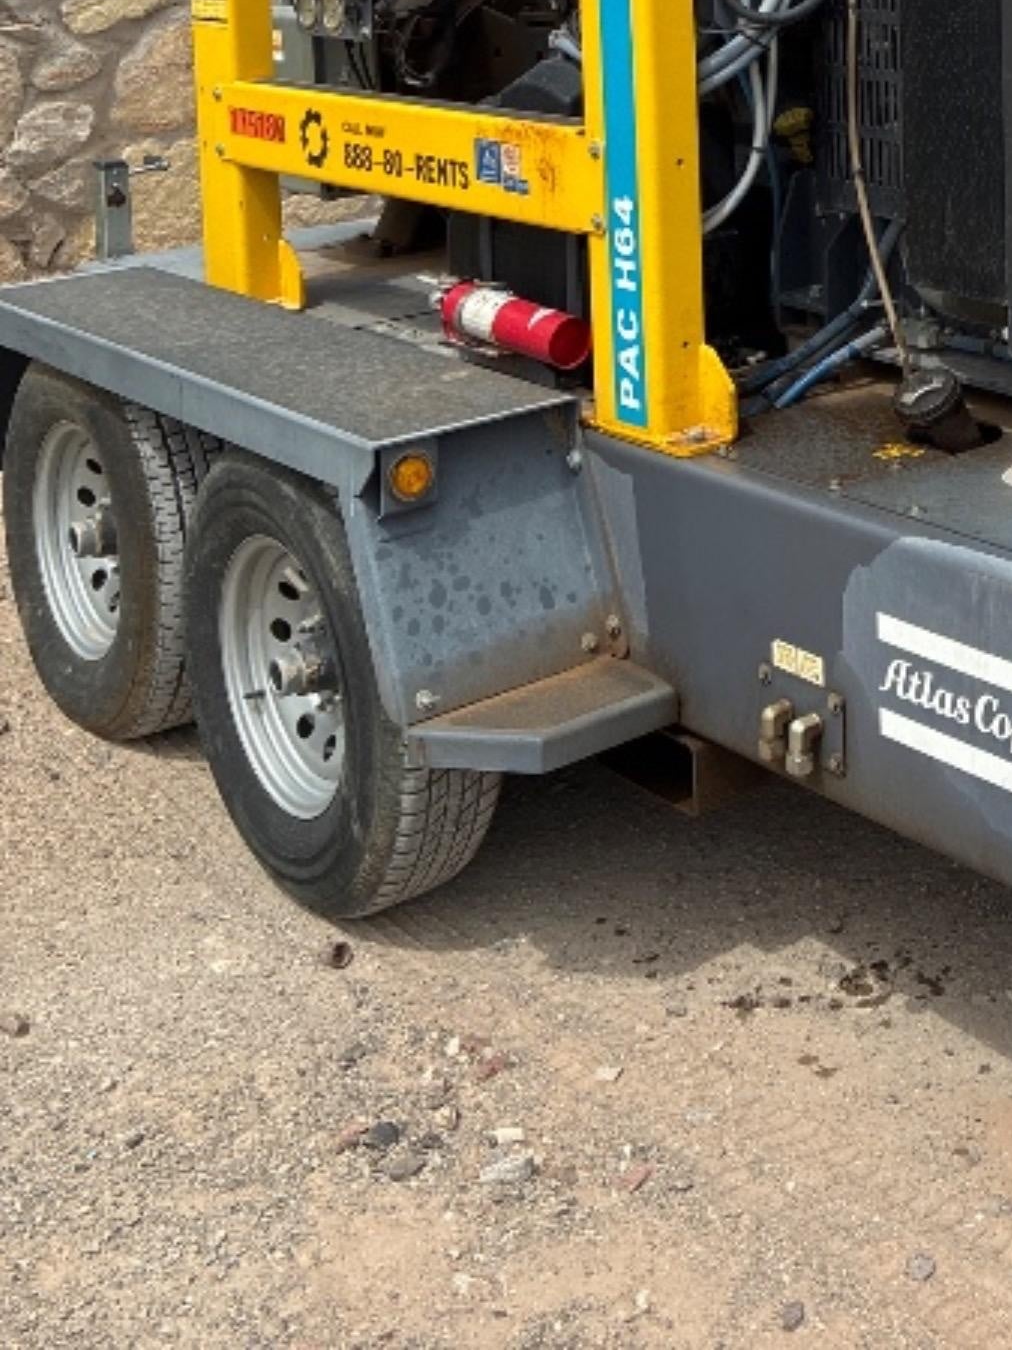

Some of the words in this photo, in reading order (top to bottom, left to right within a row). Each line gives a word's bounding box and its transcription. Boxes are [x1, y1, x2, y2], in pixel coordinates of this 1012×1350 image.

[344, 143, 469, 190] 888-80-RENTS
[613, 194, 638, 291] H64
[616, 308, 642, 411] PAC
[879, 658, 970, 723] Atlas
